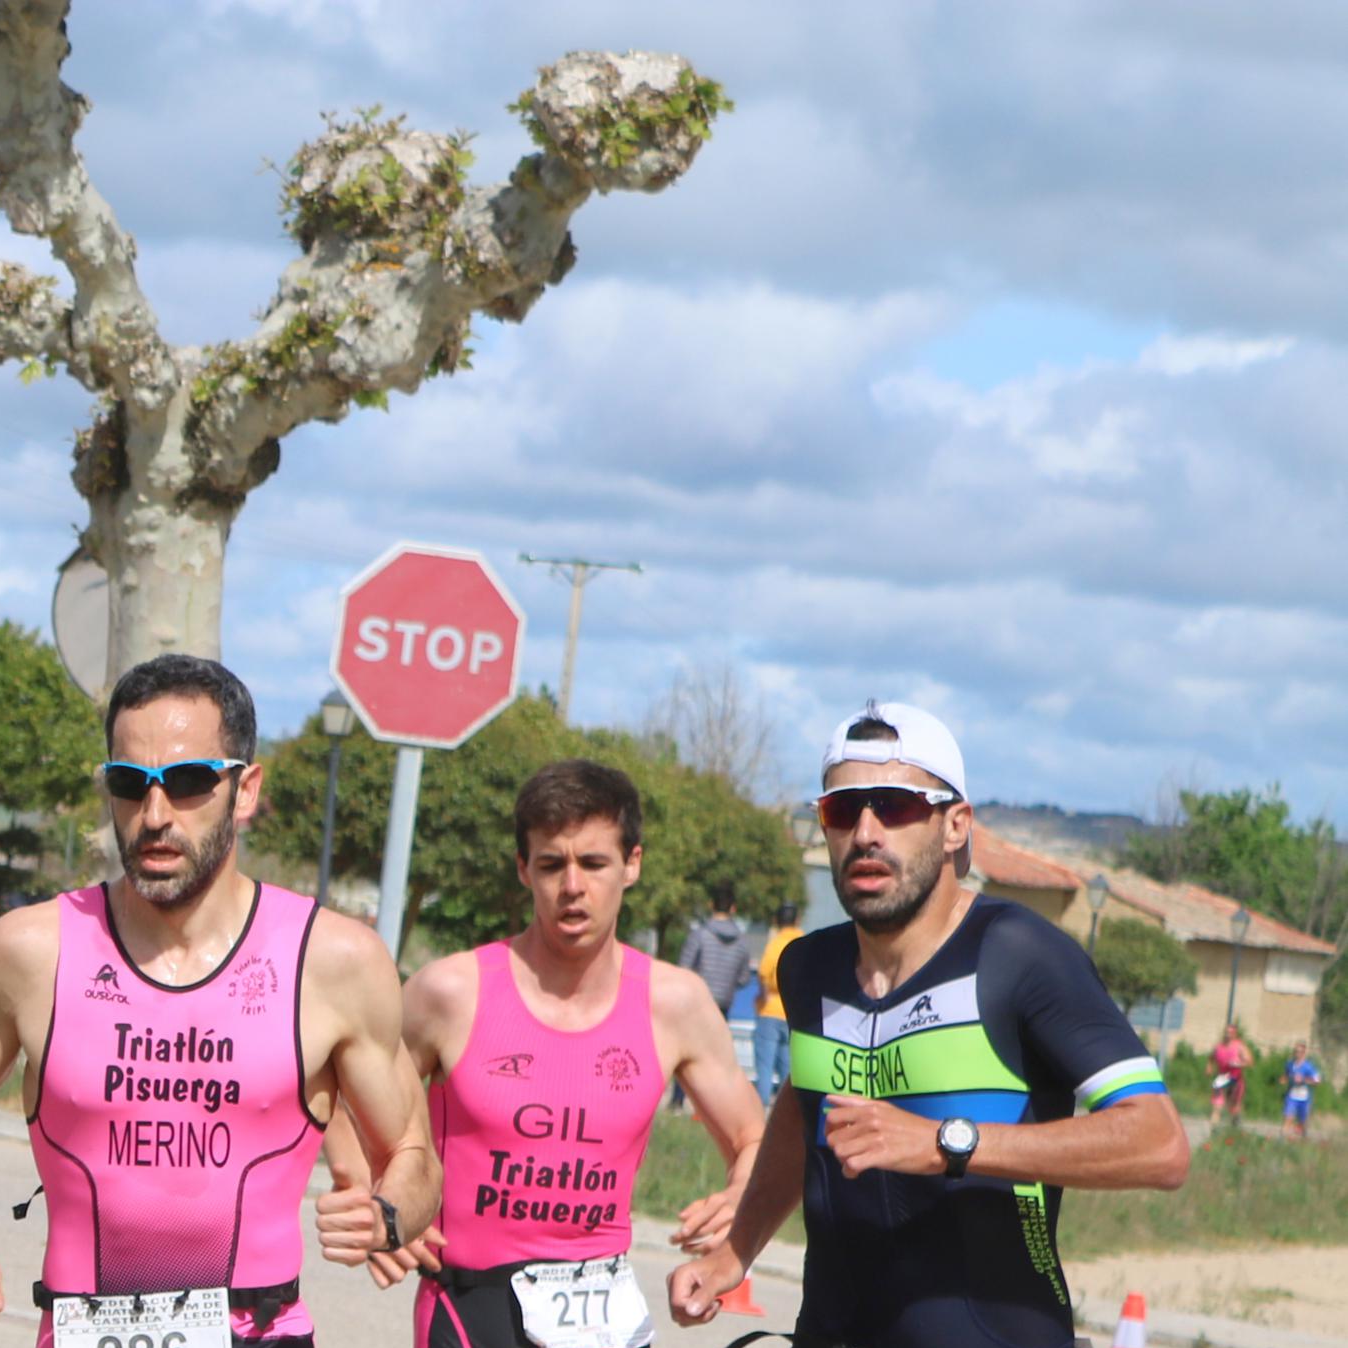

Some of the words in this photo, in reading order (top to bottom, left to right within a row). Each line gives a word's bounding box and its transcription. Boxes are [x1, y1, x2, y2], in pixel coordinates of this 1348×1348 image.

[354, 616, 503, 675] STOP
[115, 1023, 234, 1063] Triatlón
[105, 1065, 240, 1113] Pisuerga
[831, 1045, 909, 1096] SERNA
[108, 1121, 231, 1168] MERINO
[513, 1104, 603, 1144] GIL
[489, 1150, 617, 1192] Triatlón
[475, 1185, 617, 1232] Pisuerga
[551, 1290, 610, 1327] 277
